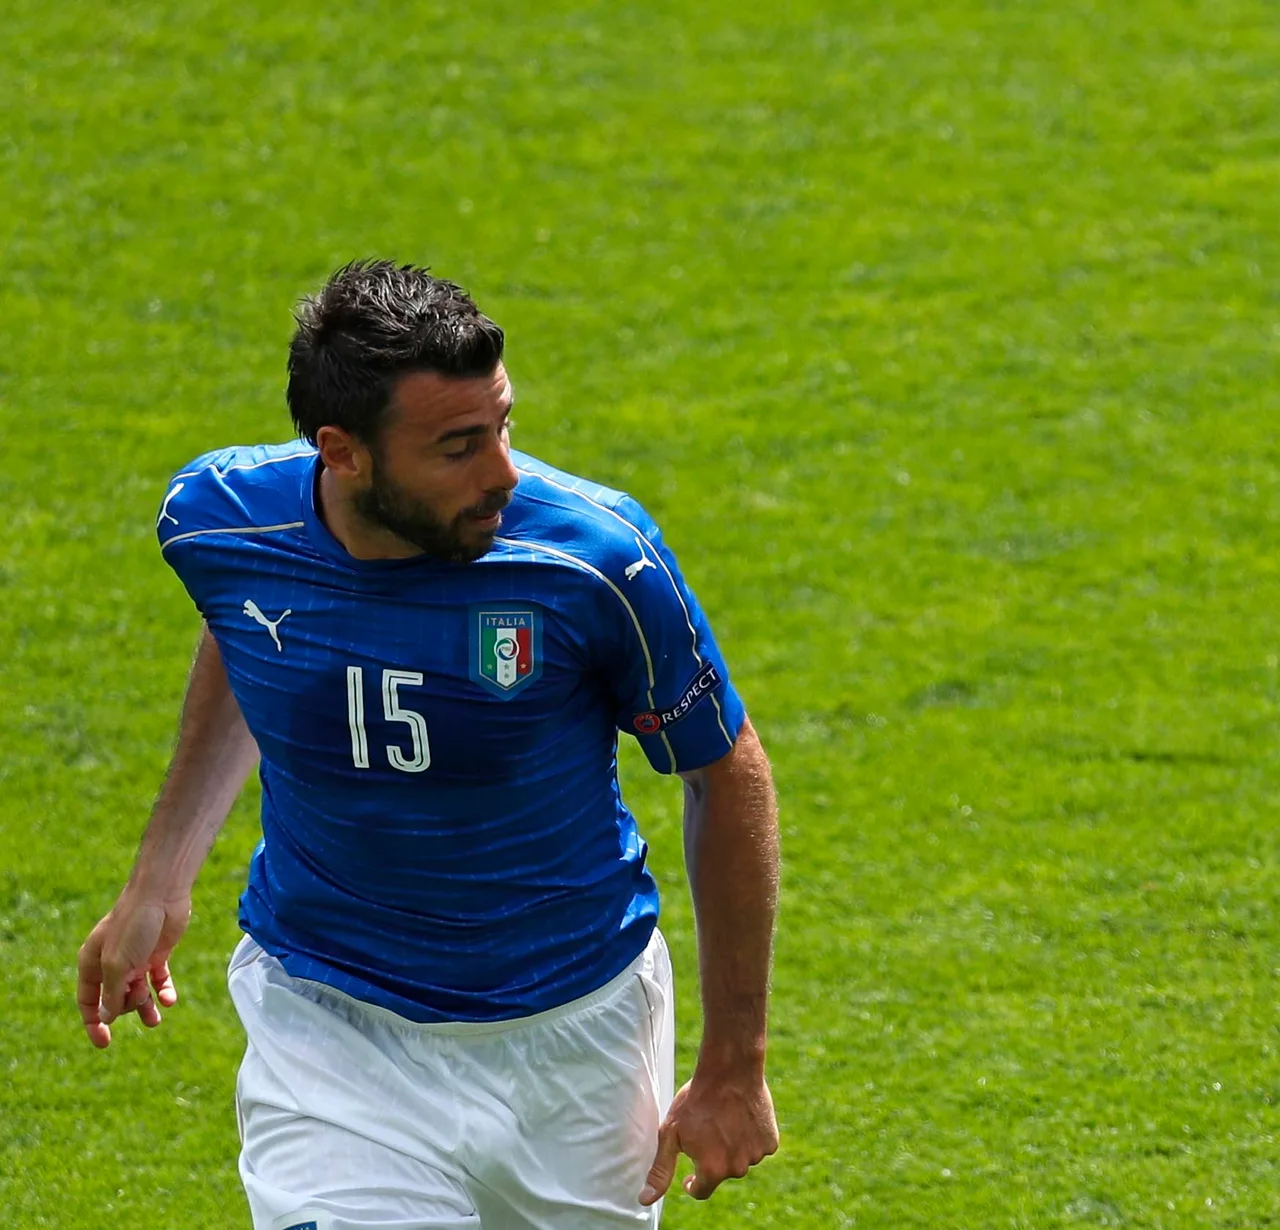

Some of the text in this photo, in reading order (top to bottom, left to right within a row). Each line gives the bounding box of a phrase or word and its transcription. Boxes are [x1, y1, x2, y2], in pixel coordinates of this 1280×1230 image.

[486, 617, 526, 626] ITALIA
[346, 665, 431, 772] 15
[662, 667, 717, 724] RESPECT
